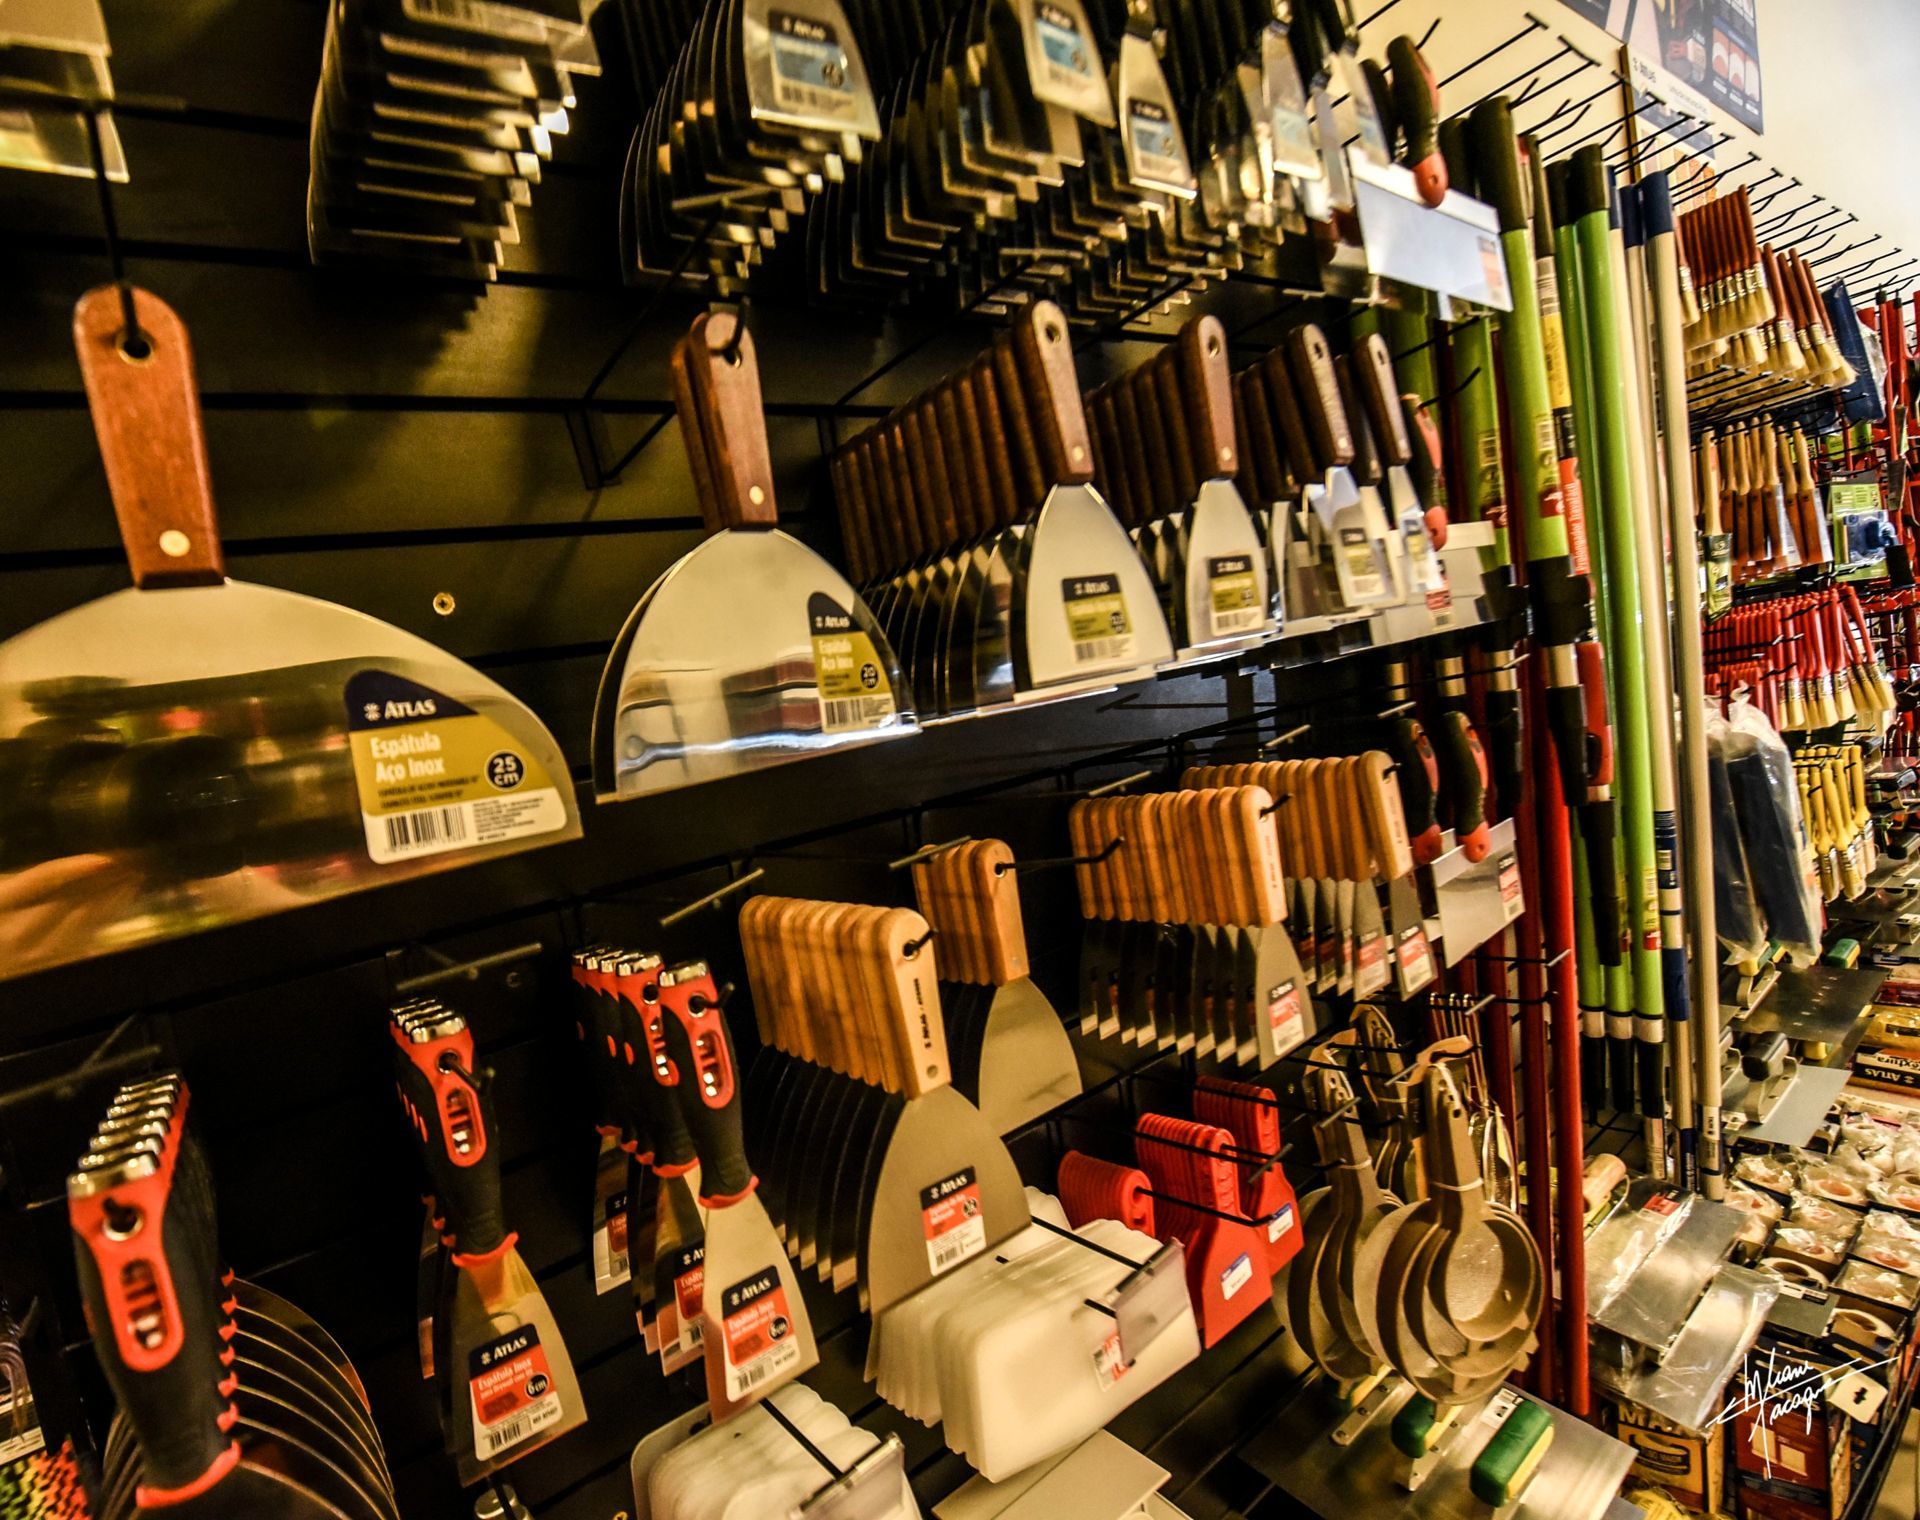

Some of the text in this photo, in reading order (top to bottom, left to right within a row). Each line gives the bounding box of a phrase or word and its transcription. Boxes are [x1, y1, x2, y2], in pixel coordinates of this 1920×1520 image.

[384, 699, 437, 720] ATLAS
[370, 731, 442, 760] Espátula
[375, 756, 446, 784] Aço Inox
[493, 756, 518, 774] 25
[494, 772, 519, 786] cm
[1877, 1054, 1920, 1071] extura
[1864, 1068, 1901, 1082] ATLAS
[940, 1174, 968, 1196] ATLAS
[741, 1277, 772, 1302] ATLAS
[494, 1336, 528, 1360] ATLAS
